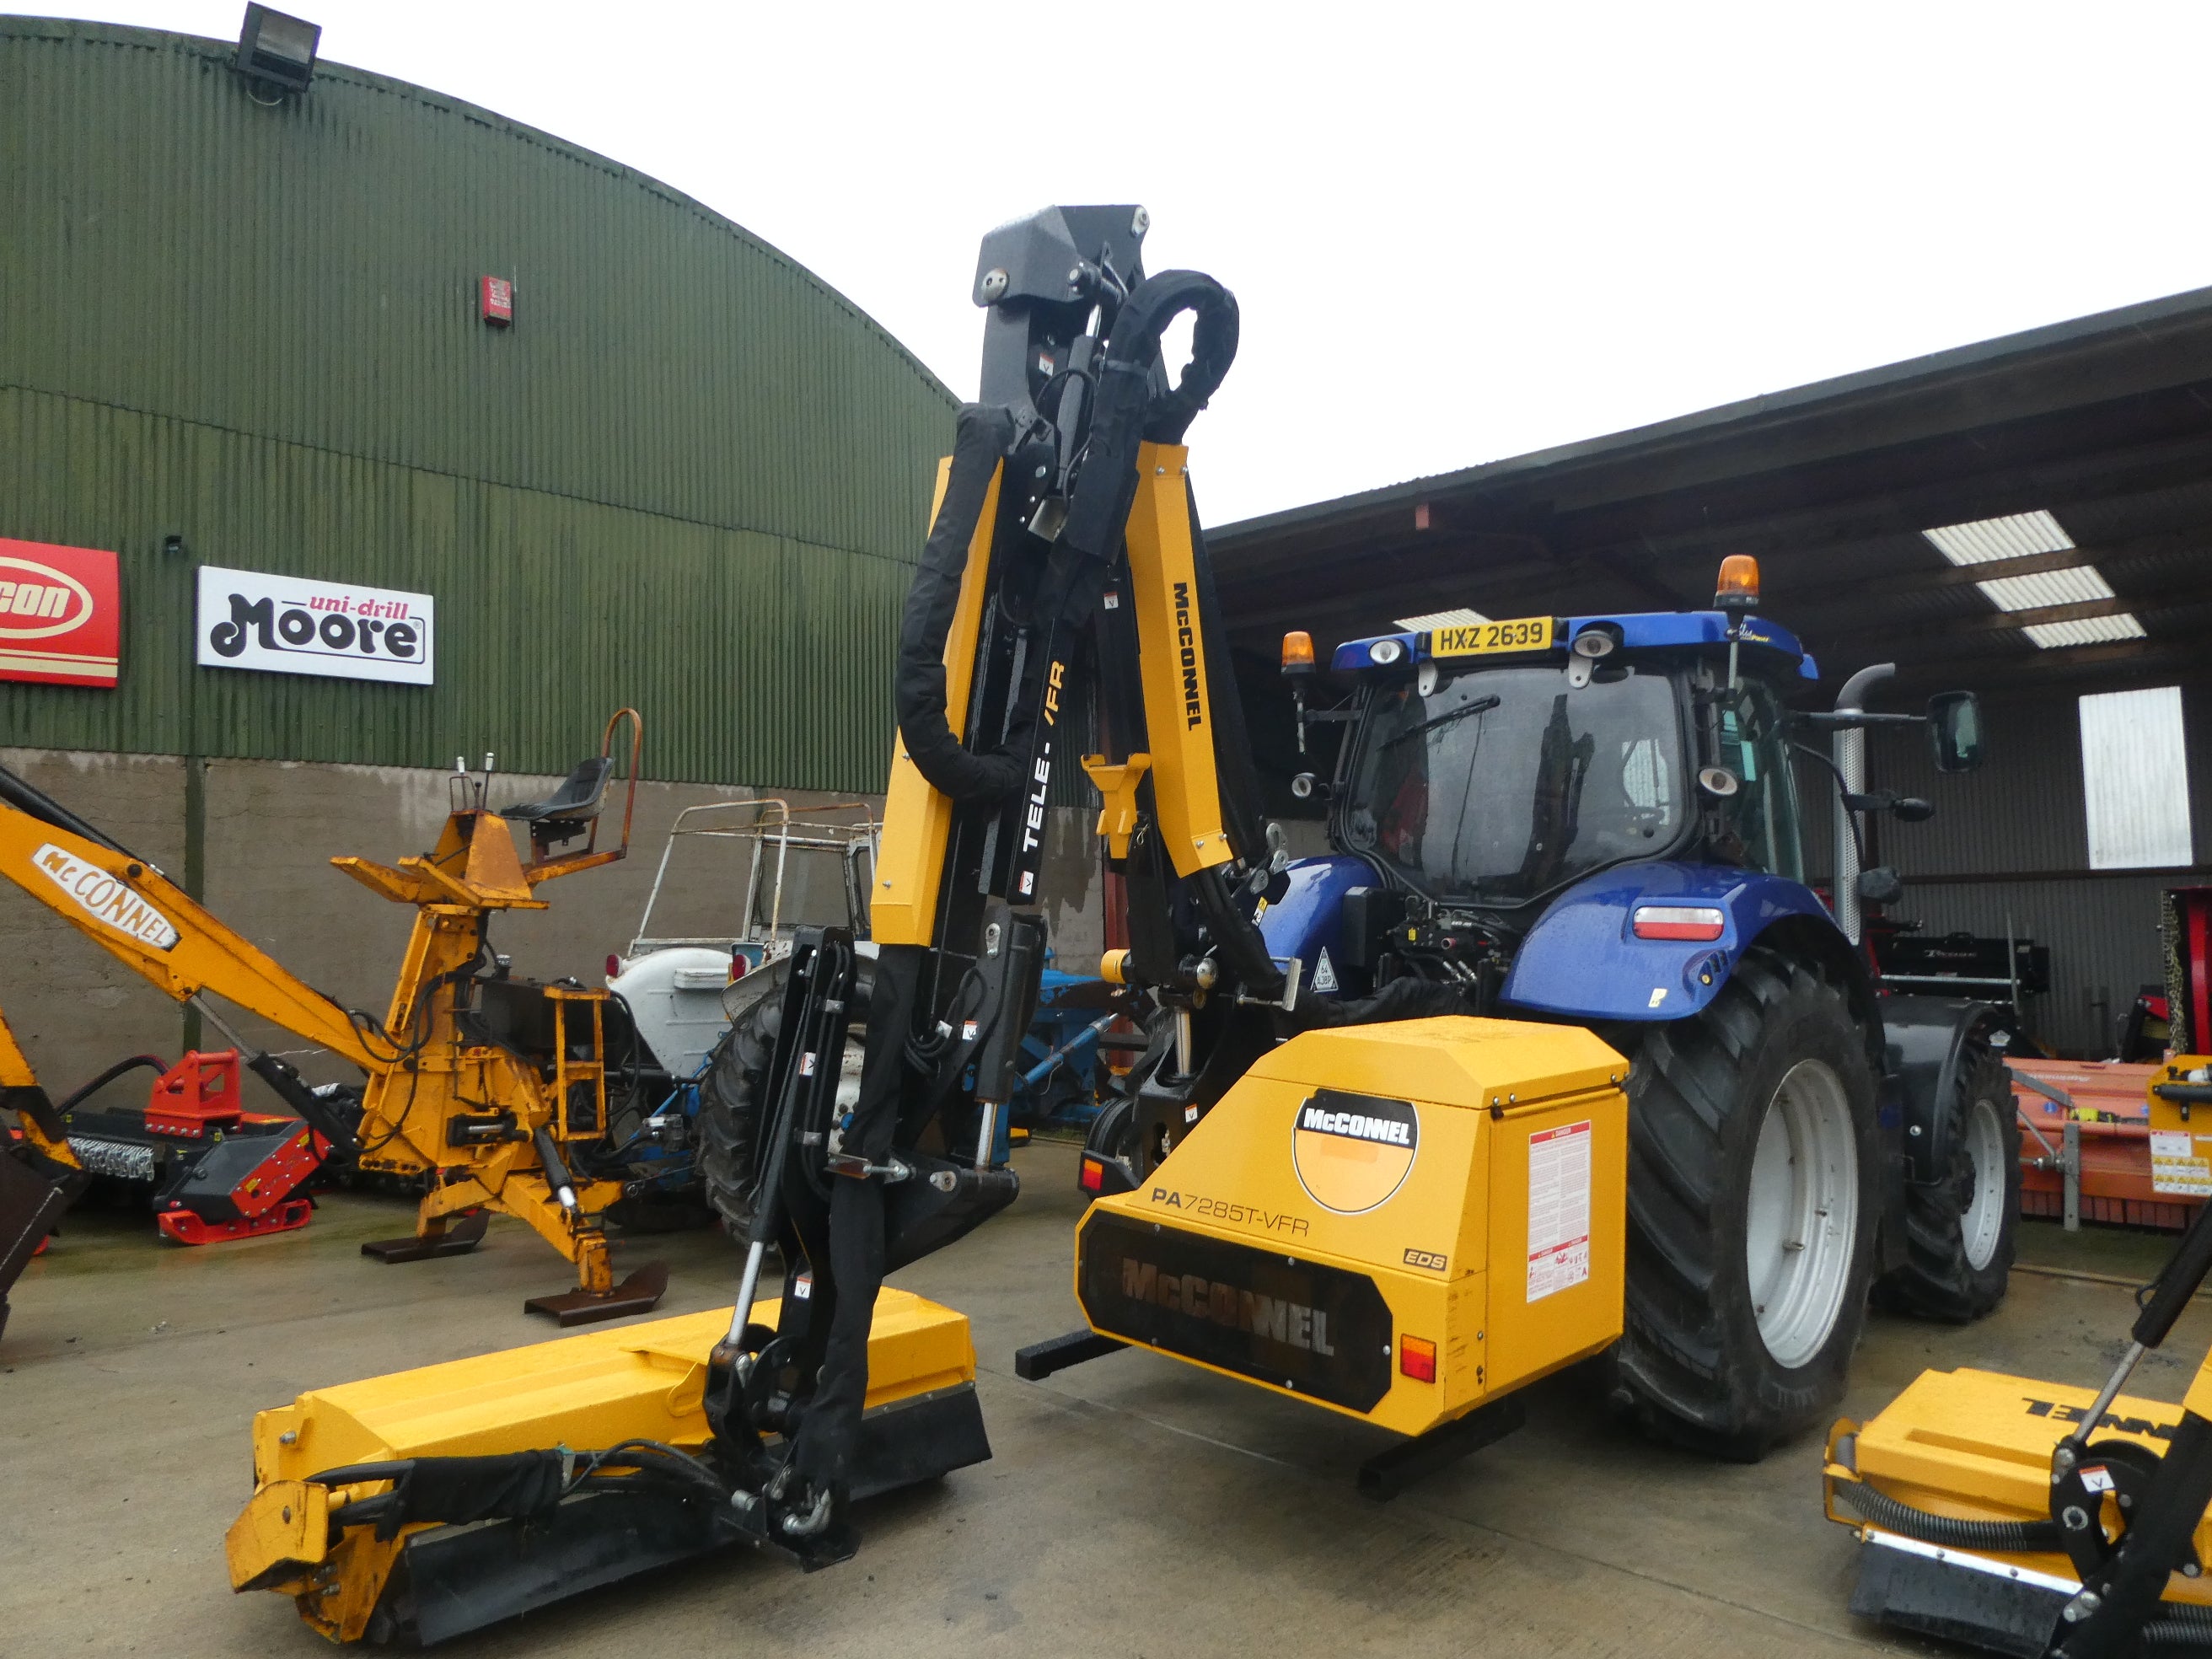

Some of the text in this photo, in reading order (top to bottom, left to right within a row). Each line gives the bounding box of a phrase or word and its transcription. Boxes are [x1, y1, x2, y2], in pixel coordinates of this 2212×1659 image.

[0, 581, 71, 619] con
[309, 596, 409, 620] uni-drill
[210, 593, 418, 658] Moore
[1441, 622, 1543, 651] HXZ 2639
[1404, 1250, 1446, 1269] EDS
